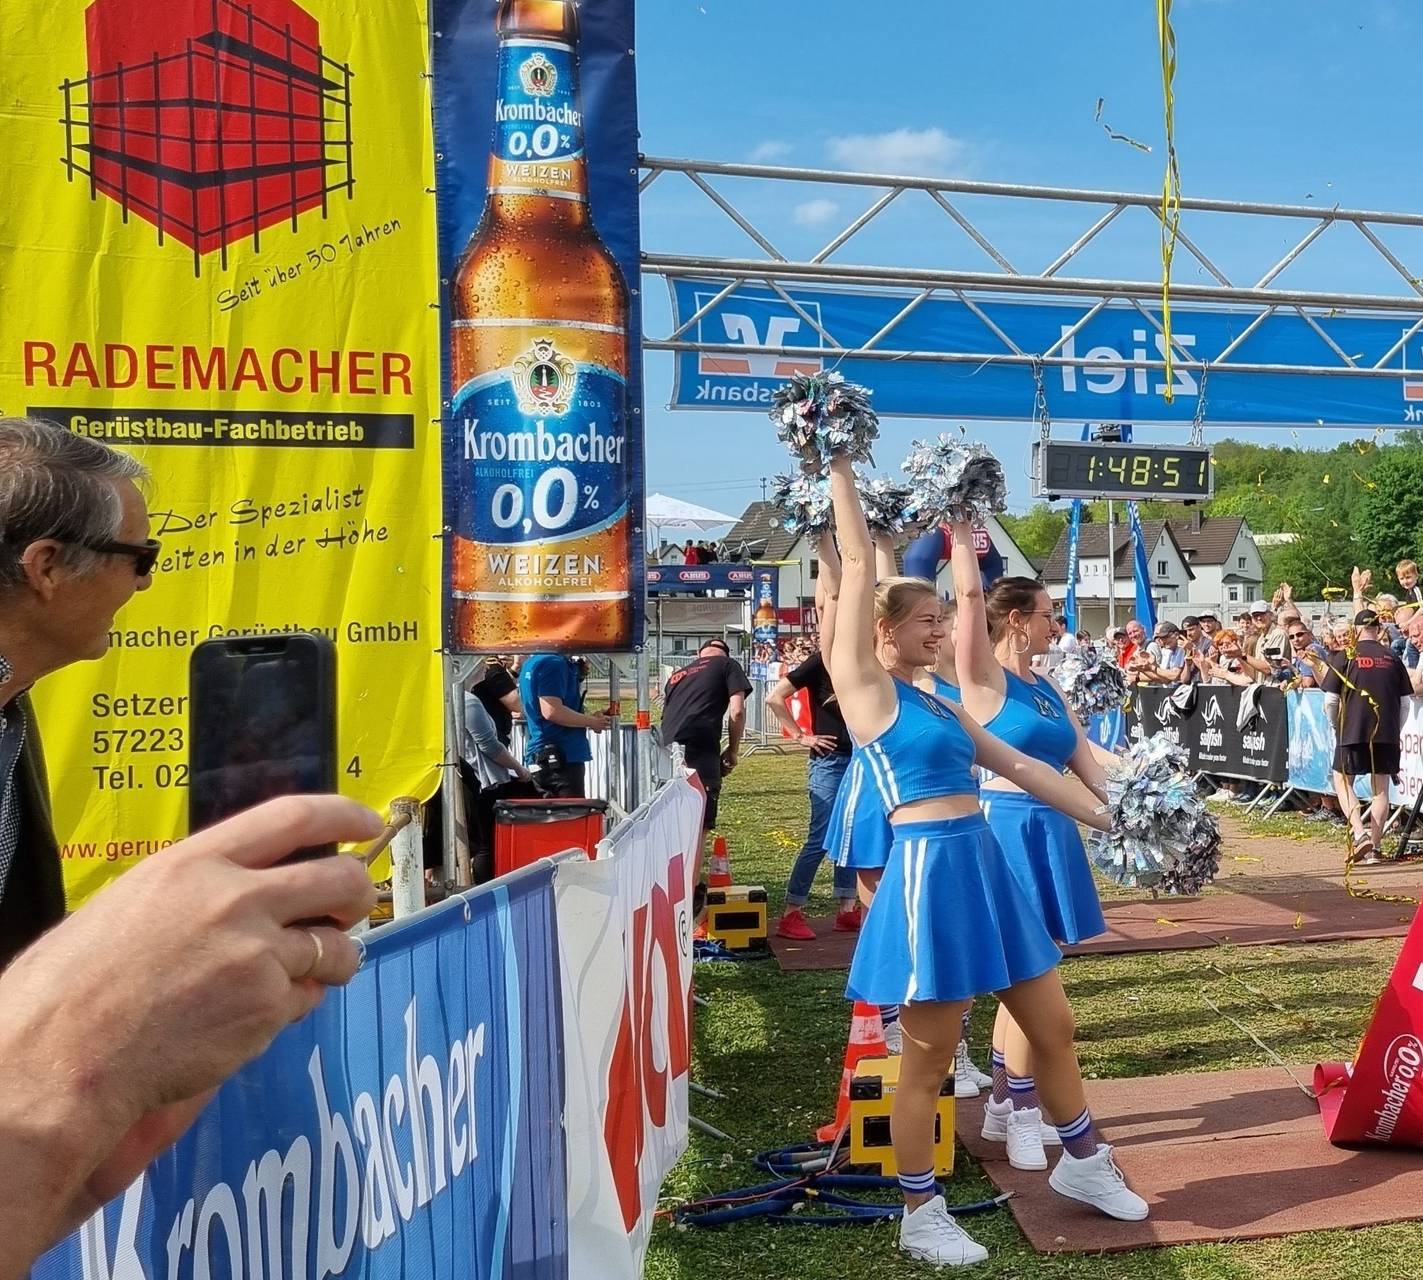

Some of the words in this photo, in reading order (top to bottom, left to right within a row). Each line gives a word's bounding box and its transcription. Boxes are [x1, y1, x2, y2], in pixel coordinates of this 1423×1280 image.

[496, 98, 581, 127] Krombacher
[507, 164, 572, 181] WEIZEN
[216, 279, 262, 312] Seit
[263, 261, 303, 293] über
[305, 242, 337, 272] 50
[339, 218, 403, 258] Jahren
[23, 340, 413, 396] RADEMACHER
[487, 399, 511, 407] SEIT
[70, 413, 365, 444] Gerüstbau-Fachbetrieb
[464, 417, 625, 464] Krombacher
[474, 467, 535, 479] ALKOHOLFREI
[1088, 455, 1206, 488] 1:48:51
[148, 507, 218, 537] Der
[229, 483, 365, 529] Spezialist
[149, 545, 225, 576] eiten
[234, 539, 256, 564] in
[265, 536, 306, 558] der
[315, 519, 389, 553] Höhe
[488, 553, 601, 576] WEIZEN
[498, 577, 593, 587] ALKOHOLFREI
[108, 622, 200, 650] macher
[347, 620, 419, 644] GmbH
[92, 692, 188, 719] Setzer
[92, 727, 185, 754] 57223
[1199, 727, 1223, 752] sailfish
[93, 765, 144, 790] Tel.
[155, 763, 190, 787] 02
[60, 837, 185, 861] ww.gerue
[1364, 1074, 1412, 1142] Krombacher
